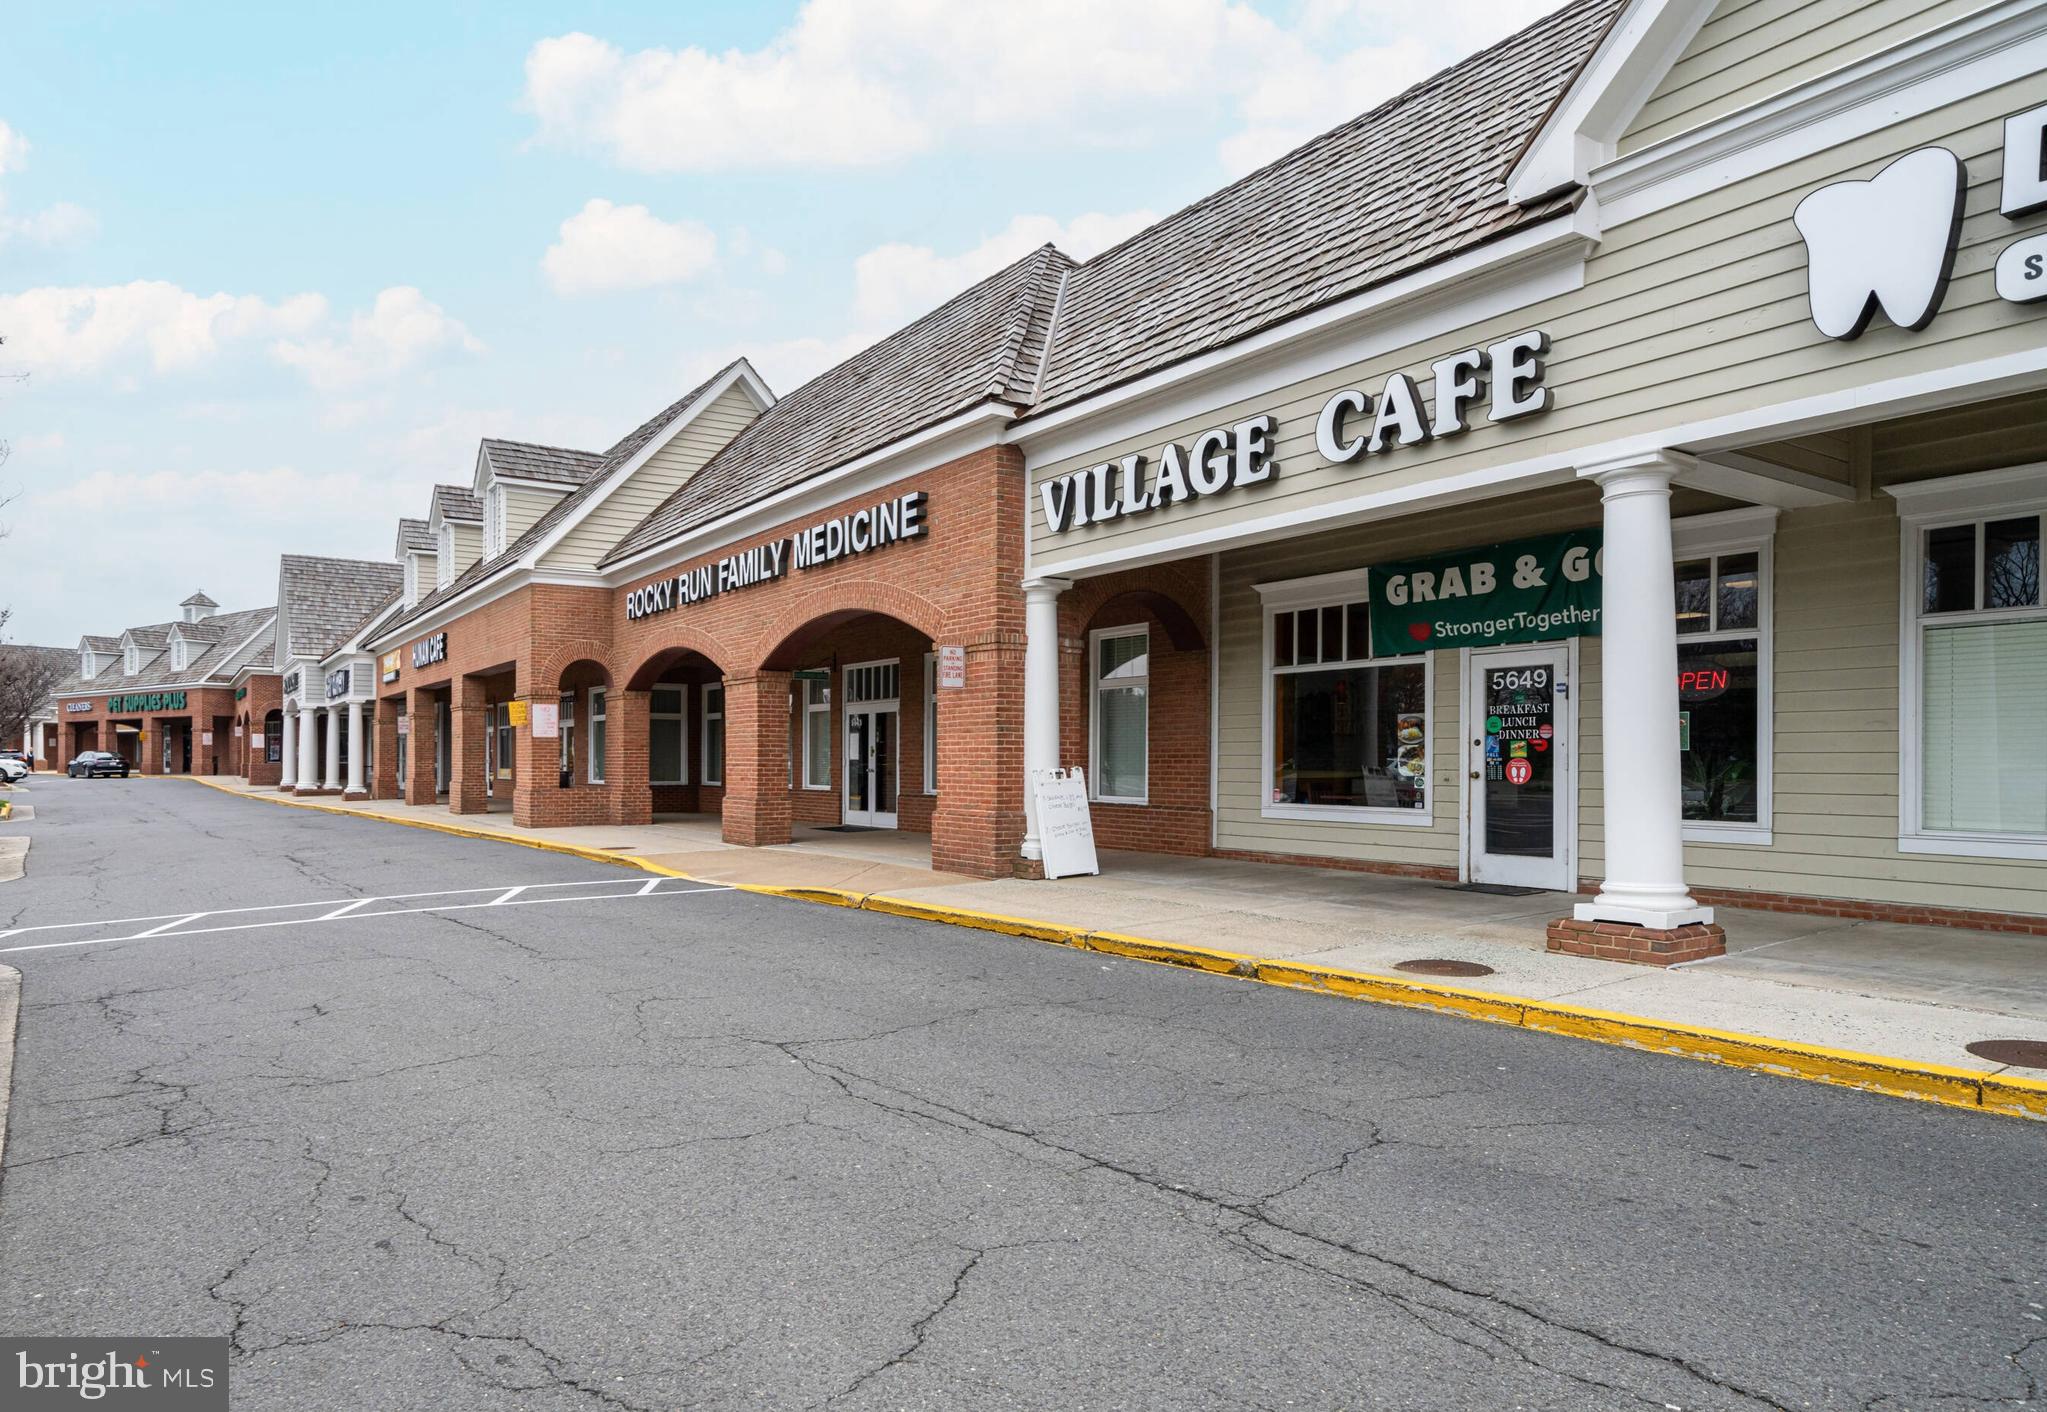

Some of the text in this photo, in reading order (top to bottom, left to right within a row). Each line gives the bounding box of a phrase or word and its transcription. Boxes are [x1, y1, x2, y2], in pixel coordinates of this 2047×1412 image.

[1039, 330, 1554, 533] VILLAGE CAFE
[626, 491, 928, 620] ROCKY RUN FAMILY MEDICINE
[1385, 546, 1604, 606] GRAB & G
[1434, 604, 1601, 638] StrongerTogether
[430, 632, 448, 664] CAFE
[1492, 669, 1548, 690] 5649
[1675, 670, 1728, 691] PEN
[66, 701, 93, 713] CLEANERS
[107, 690, 188, 713] PET SUPPLIES PLUS
[1489, 703, 1550, 715] BREAKFAST
[1502, 716, 1537, 727] LUNCH
[1499, 729, 1540, 740] DINNER
